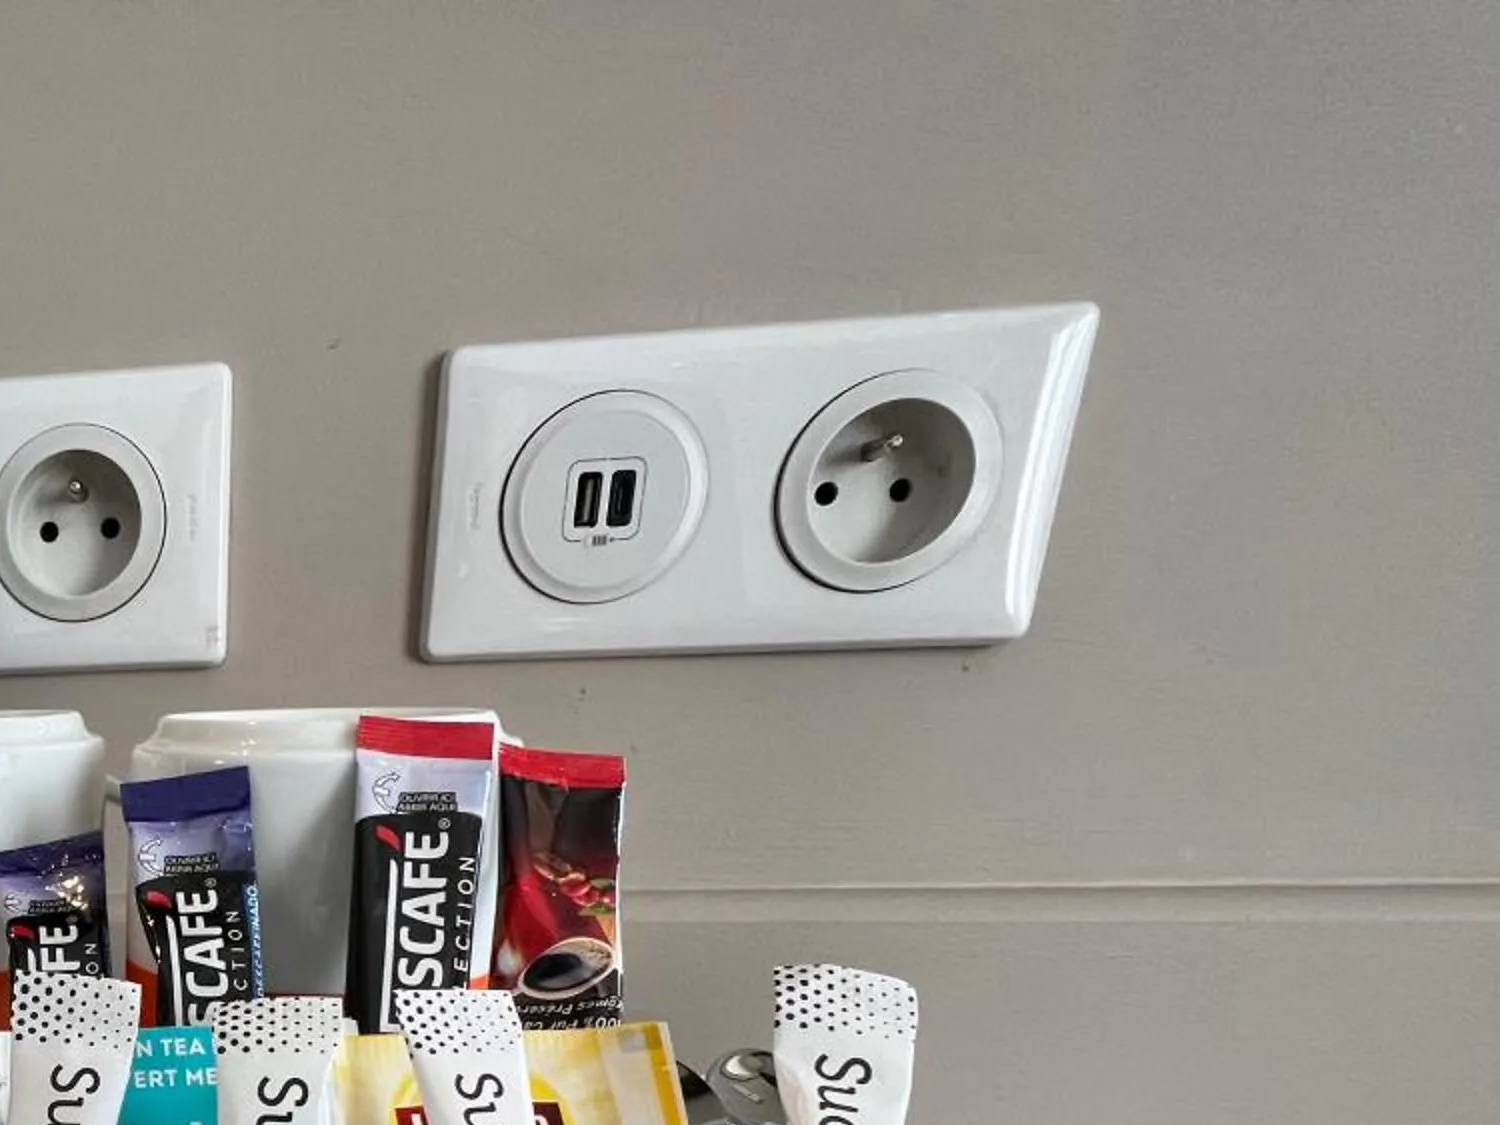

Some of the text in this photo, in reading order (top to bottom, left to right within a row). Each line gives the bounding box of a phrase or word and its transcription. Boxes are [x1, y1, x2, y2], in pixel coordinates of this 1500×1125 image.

[225, 911, 248, 991] CTION
[159, 1037, 207, 1057] TEA
[133, 1068, 178, 1089] ERT
